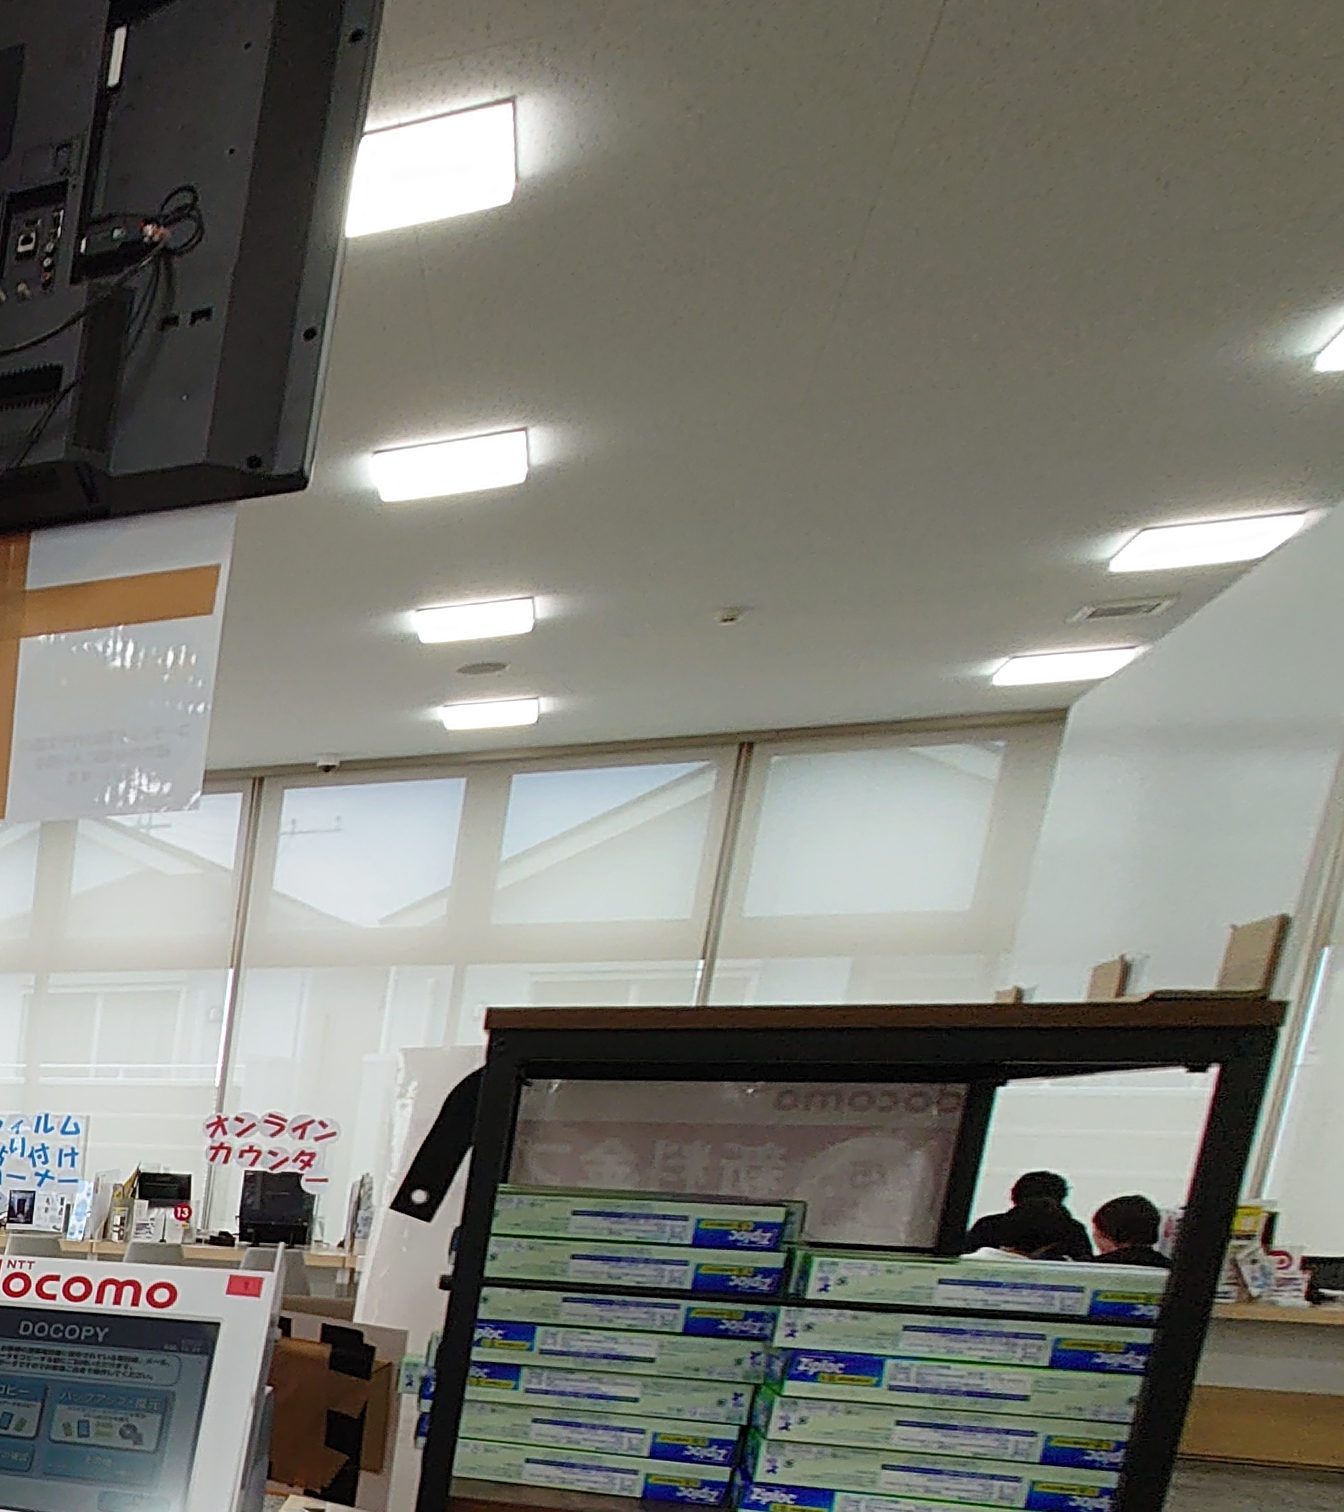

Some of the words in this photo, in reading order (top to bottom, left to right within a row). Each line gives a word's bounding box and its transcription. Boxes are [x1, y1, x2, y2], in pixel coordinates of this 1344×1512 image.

[205, 1113, 338, 1142] オンライン
[177, 1207, 189, 1218] 13
[7, 1259, 35, 1269] NTT
[19, 1320, 110, 1343] DOCOPY
